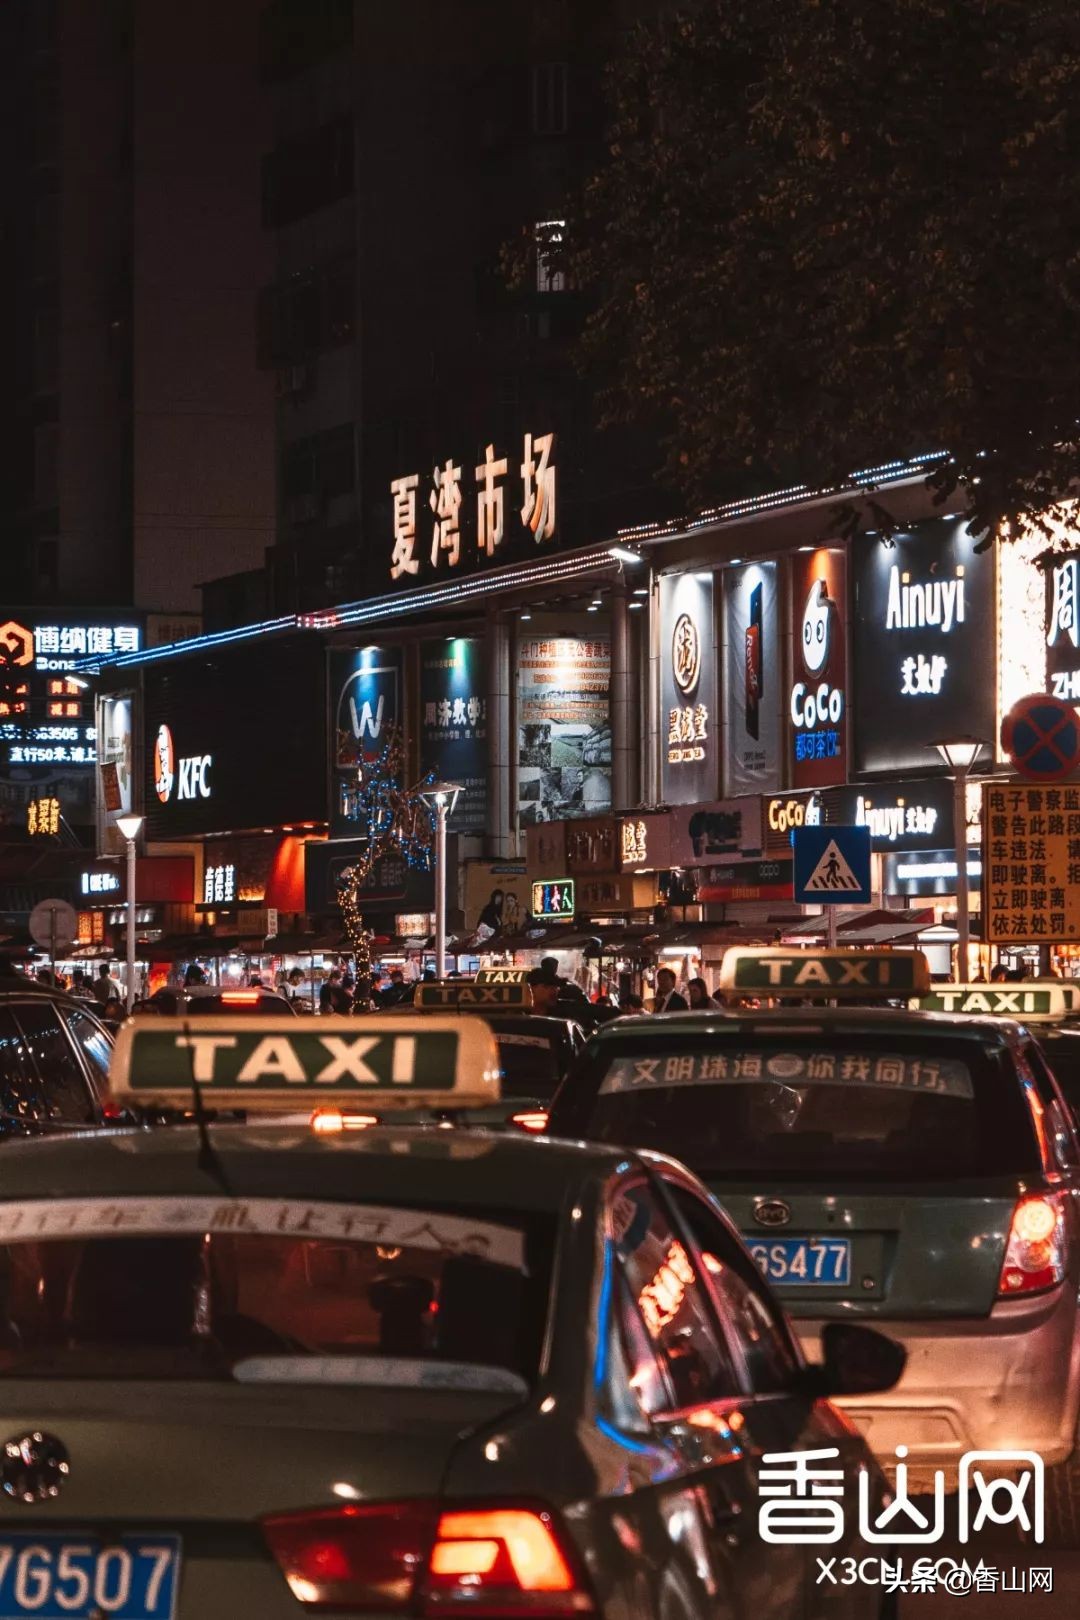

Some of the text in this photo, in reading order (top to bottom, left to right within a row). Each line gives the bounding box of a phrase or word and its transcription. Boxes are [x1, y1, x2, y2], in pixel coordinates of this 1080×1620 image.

[390, 432, 556, 580] 夏湾市场
[886, 564, 965, 632] Ainuyi
[34, 626, 139, 653] 博纳健身
[796, 730, 840, 760] 都可茶饮
[177, 755, 212, 800] KFC
[485, 971, 524, 983] TAXI
[759, 960, 891, 985] TAXI
[436, 988, 509, 1001] TAXI
[935, 991, 1035, 1013] TAXI
[175, 1035, 418, 1083] TAXI
[632, 1057, 940, 1086] 文明珠海 你我同行
